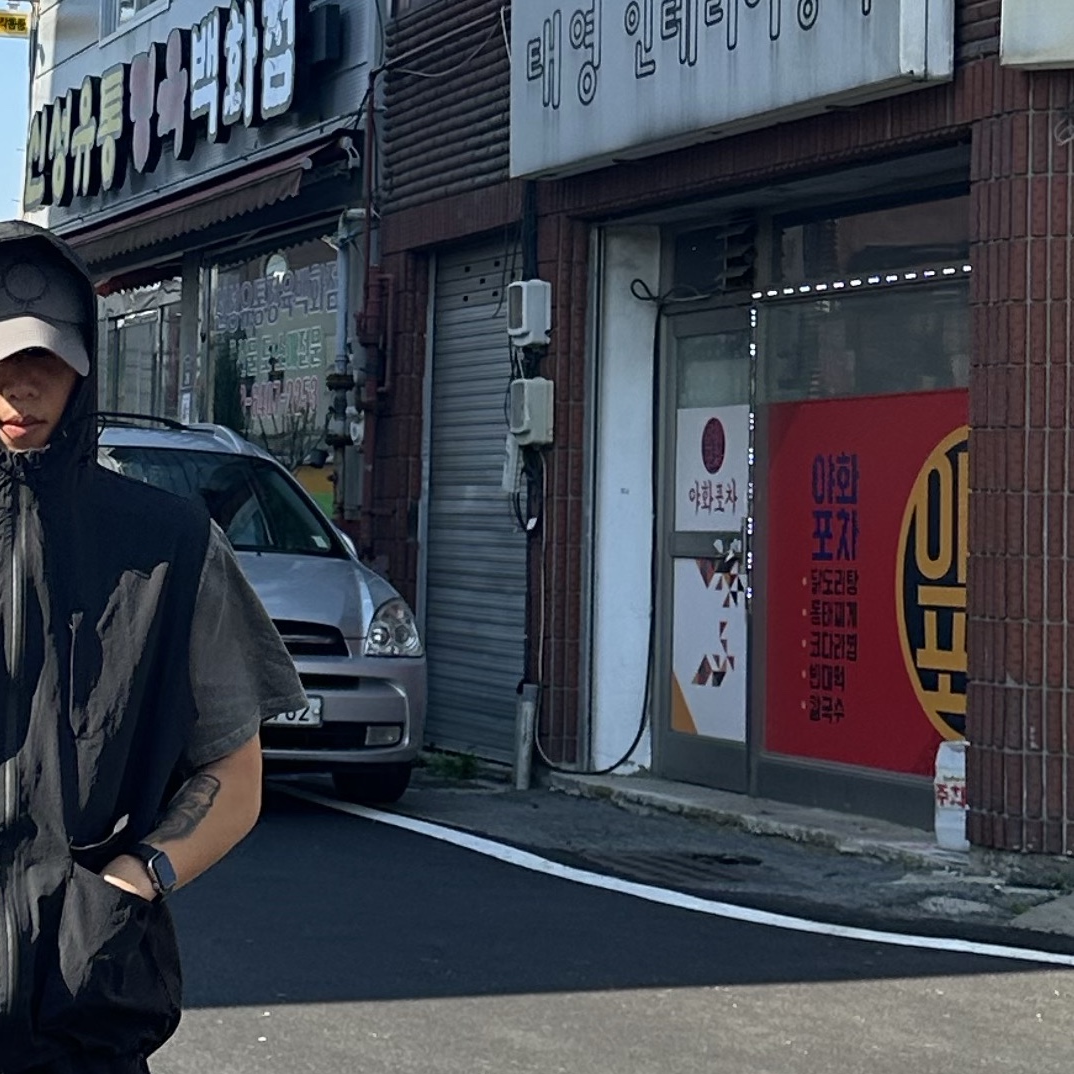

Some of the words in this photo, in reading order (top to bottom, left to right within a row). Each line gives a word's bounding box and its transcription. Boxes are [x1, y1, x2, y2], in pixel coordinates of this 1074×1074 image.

[527, 0, 602, 109] 태영
[689, 478, 738, 515] 야화포차
[812, 452, 859, 505] 야화
[812, 508, 859, 561] 포차
